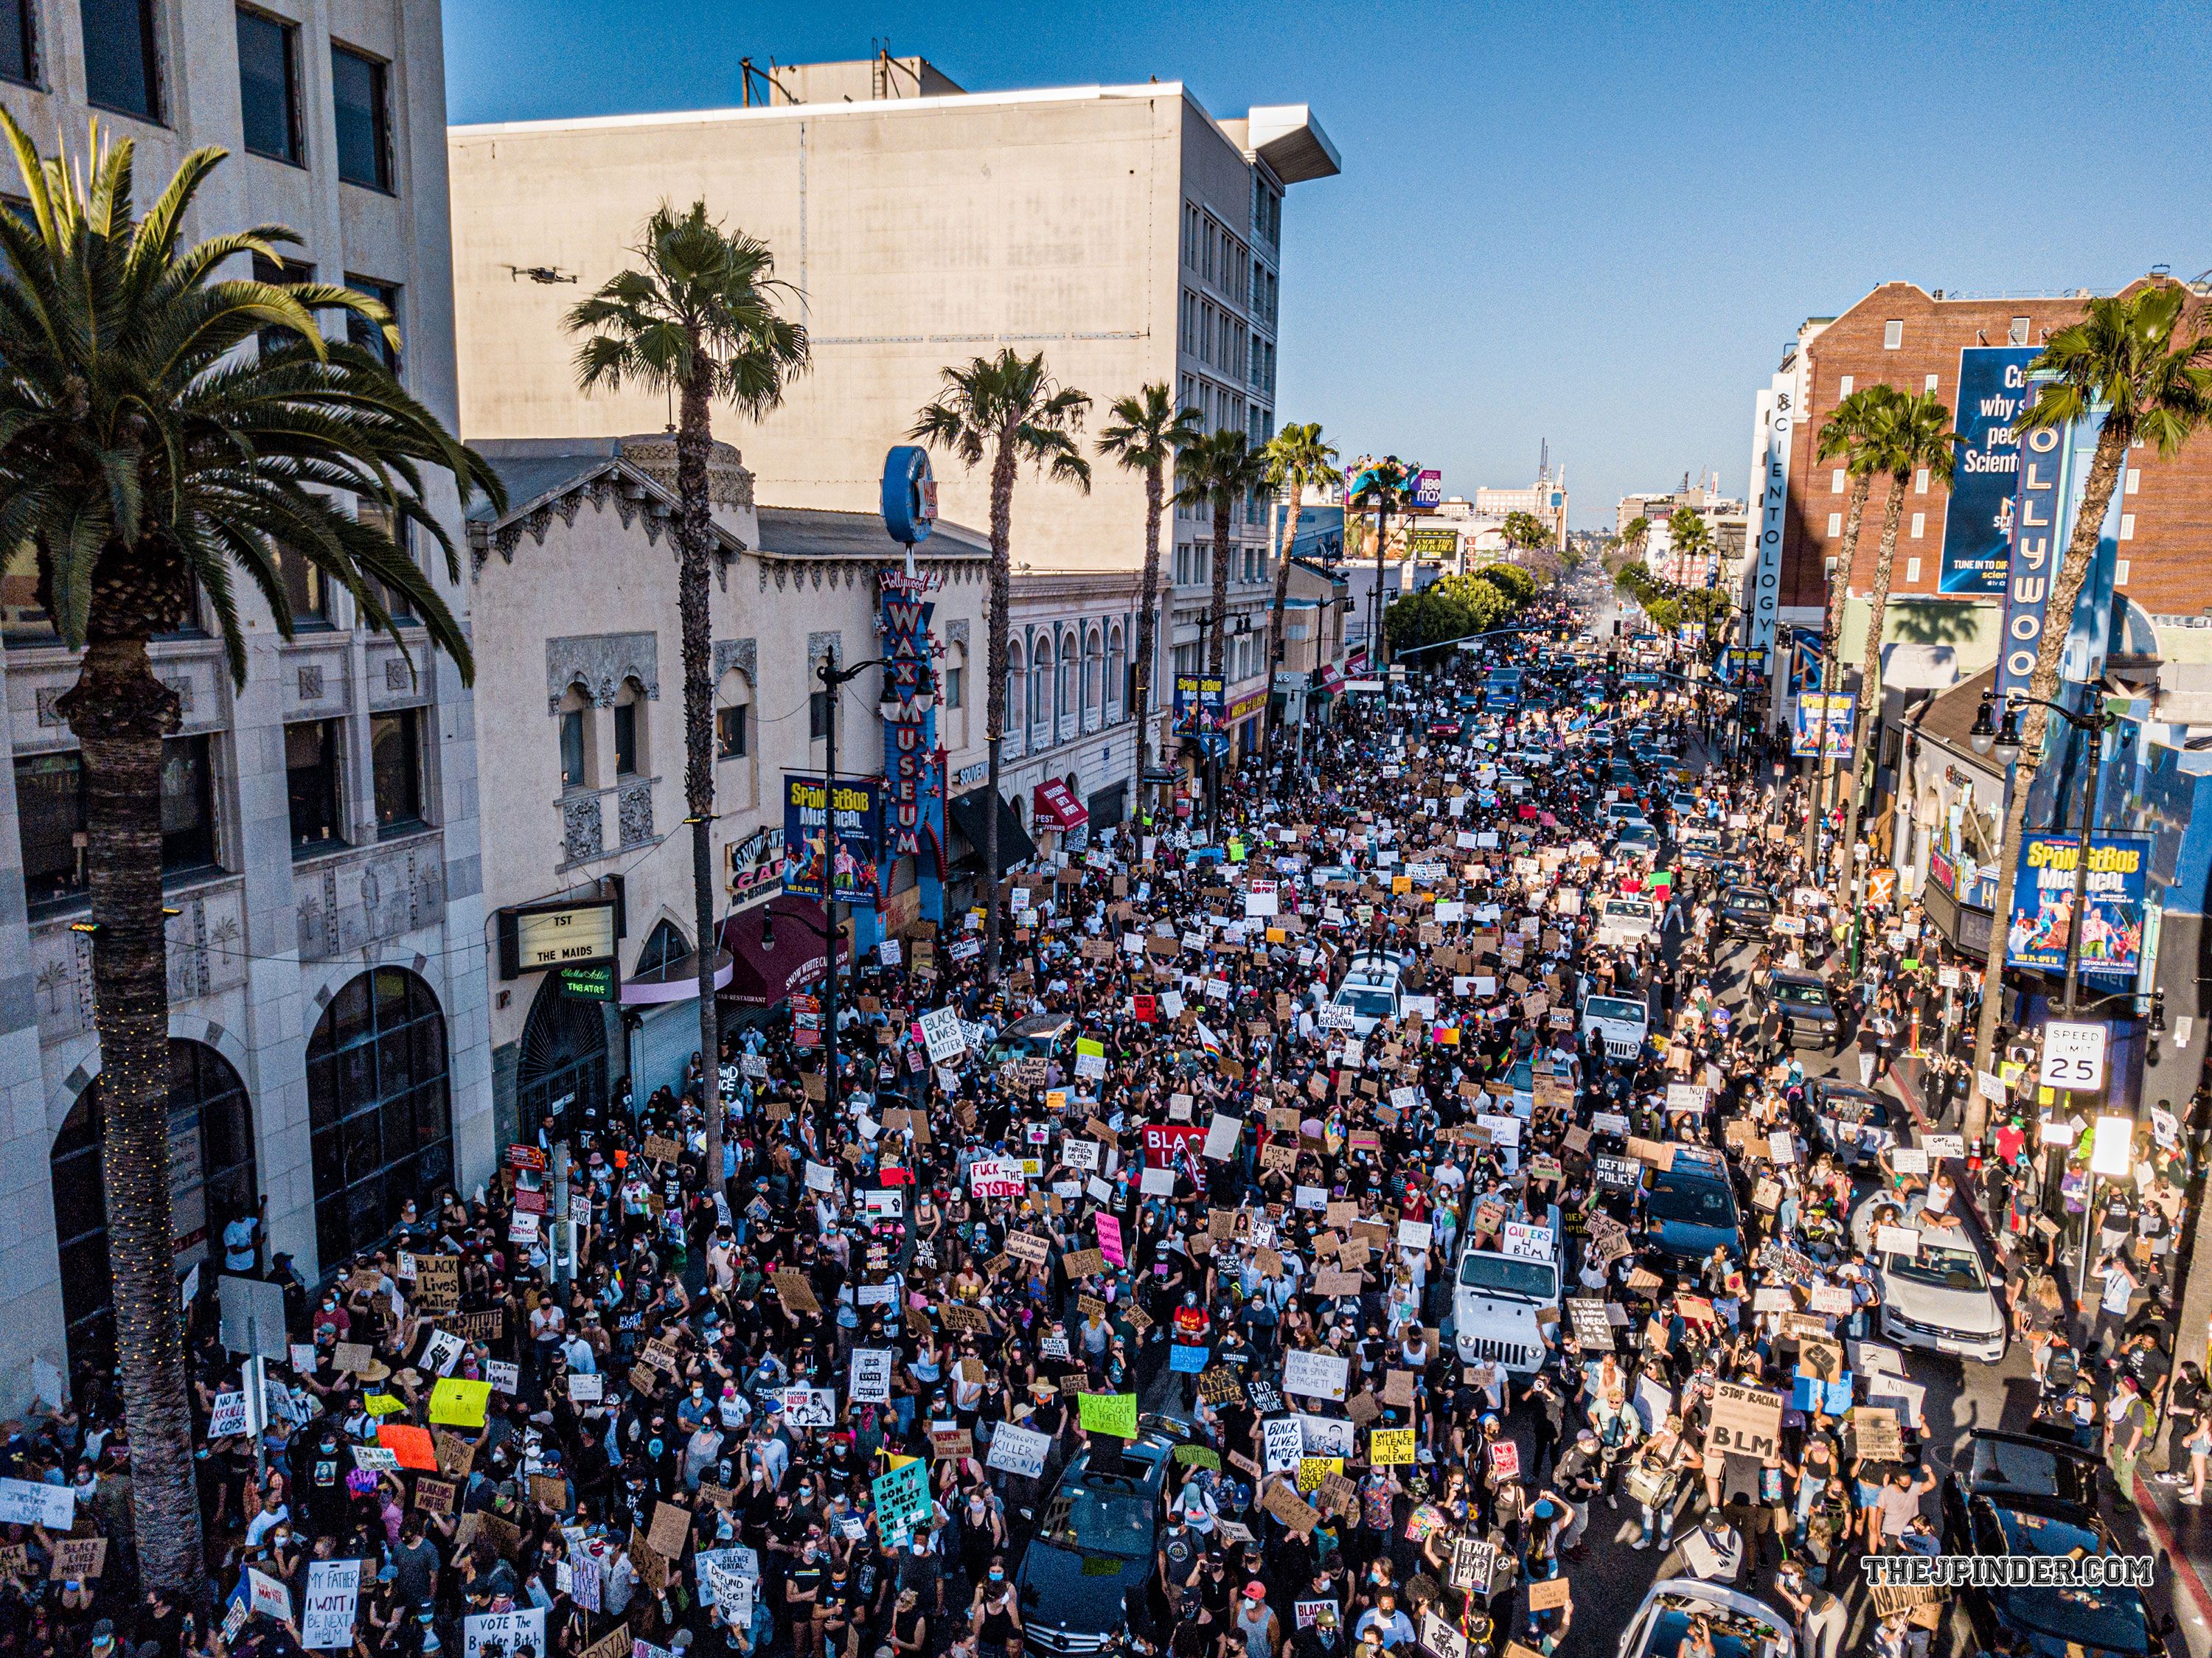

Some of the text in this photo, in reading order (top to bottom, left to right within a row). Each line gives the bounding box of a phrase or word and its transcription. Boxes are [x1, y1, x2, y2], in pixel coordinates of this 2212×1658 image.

[1980, 394, 2015, 417] why
[1421, 478, 1440, 490] HBO
[1417, 490, 1440, 502] max
[1954, 560, 1994, 569] TUNE IN TO
[878, 570, 928, 596] Hollywood
[888, 602, 922, 684] WAX
[893, 694, 922, 856] MUSEUM
[1036, 815, 1054, 823] BEST
[737, 835, 765, 871] SNOW
[1065, 843, 1086, 851] SYSTEM
[554, 916, 572, 927] TST
[538, 946, 592, 961] THE MAIDS
[786, 959, 819, 991] SNOW WHITE
[799, 975, 810, 985] SINCE
[567, 983, 605, 995] THEATRE
[1323, 1006, 1352, 1015] JUSTICE
[924, 1010, 956, 1031] BLACK
[1320, 1017, 1354, 1028] BREONNA
[931, 1025, 957, 1045] LIVES
[2053, 1030, 2098, 1042] SPEED
[932, 1039, 962, 1059] MATTER
[2056, 1045, 2091, 1053] LIMIT
[1022, 1058, 1047, 1067] BLACK
[1020, 1067, 1045, 1076] Lives
[2050, 1059, 2093, 1081] 25
[1019, 1076, 1046, 1086] Matter
[1006, 1079, 1029, 1100] Taylor
[1689, 1087, 1705, 1096] NOT
[1483, 1118, 1505, 1127] Black
[1148, 1130, 1208, 1149] BLAC
[1068, 1146, 1093, 1156] PROTECTS
[1265, 1146, 1290, 1157] FUCK
[973, 1163, 998, 1177] FUCK
[1263, 1159, 1290, 1171] BLM
[1597, 1158, 1640, 1174] DEFUND
[1002, 1170, 1023, 1181] THE
[1596, 1171, 1635, 1186] POLICE
[973, 1181, 1025, 1198] SYSTEM
[1098, 1218, 1119, 1230] Revolt
[1590, 1209, 1623, 1234] BLACK
[1009, 1231, 1025, 1242] FUCK
[1099, 1230, 1119, 1243] Against
[1508, 1225, 1550, 1241] QUEERS
[1522, 1239, 1531, 1248] 4
[1513, 1244, 1543, 1260] BLM
[417, 1260, 456, 1273] BLACK
[423, 1276, 457, 1291] Lives
[1816, 1289, 1843, 1300] WHITE
[419, 1295, 458, 1309] Matter
[950, 1307, 975, 1318] END
[946, 1314, 981, 1326] WHITE
[1579, 1316, 1610, 1327] AMERICA
[439, 1332, 456, 1345] BLM
[1290, 1354, 1343, 1369] MAYOR GARCETTI
[1200, 1368, 1229, 1383] BLACK
[1291, 1365, 1329, 1377] YOUR SPINE
[1201, 1376, 1237, 1392] LIVES
[1248, 1381, 1271, 1394] END
[1290, 1375, 1333, 1390] SPAGHETTI
[218, 1395, 231, 1408] NO
[787, 1396, 807, 1404] RACISM
[1203, 1386, 1242, 1404] MATTER
[1253, 1391, 1279, 1406] WHITE
[1719, 1386, 1781, 1408] STOP RACIAL
[1256, 1401, 1284, 1413] SILENCE
[219, 1420, 243, 1432] COPS
[1268, 1423, 1297, 1436] BLACK
[996, 1427, 1039, 1446] PROSECUTE
[1270, 1435, 1298, 1447] LIVES
[1377, 1431, 1409, 1439] WHITE
[993, 1438, 1033, 1458] KILLER
[1375, 1438, 1412, 1446] SILENCE
[1268, 1446, 1301, 1460] MATTER
[1388, 1446, 1399, 1454] IS
[991, 1452, 1016, 1468] COPS
[1300, 1458, 1332, 1467] DEFUND
[1374, 1453, 1412, 1462] VIOLENCE
[882, 1467, 916, 1488] IS MY
[1300, 1467, 1327, 1475] DIVEST
[880, 1485, 903, 1502] SON
[892, 1487, 921, 1505] NEXT
[880, 1501, 917, 1523] OR MY
[886, 1510, 925, 1532] NIECES
[722, 1556, 749, 1564] SILENCE
[309, 1570, 358, 1589] MY FATHER
[711, 1566, 744, 1589] DEFUND
[307, 1615, 352, 1629] BE NEXT
[480, 1615, 531, 1631] VOTE The
[315, 1629, 341, 1642] #BLM
[515, 1632, 541, 1647] Bitch
